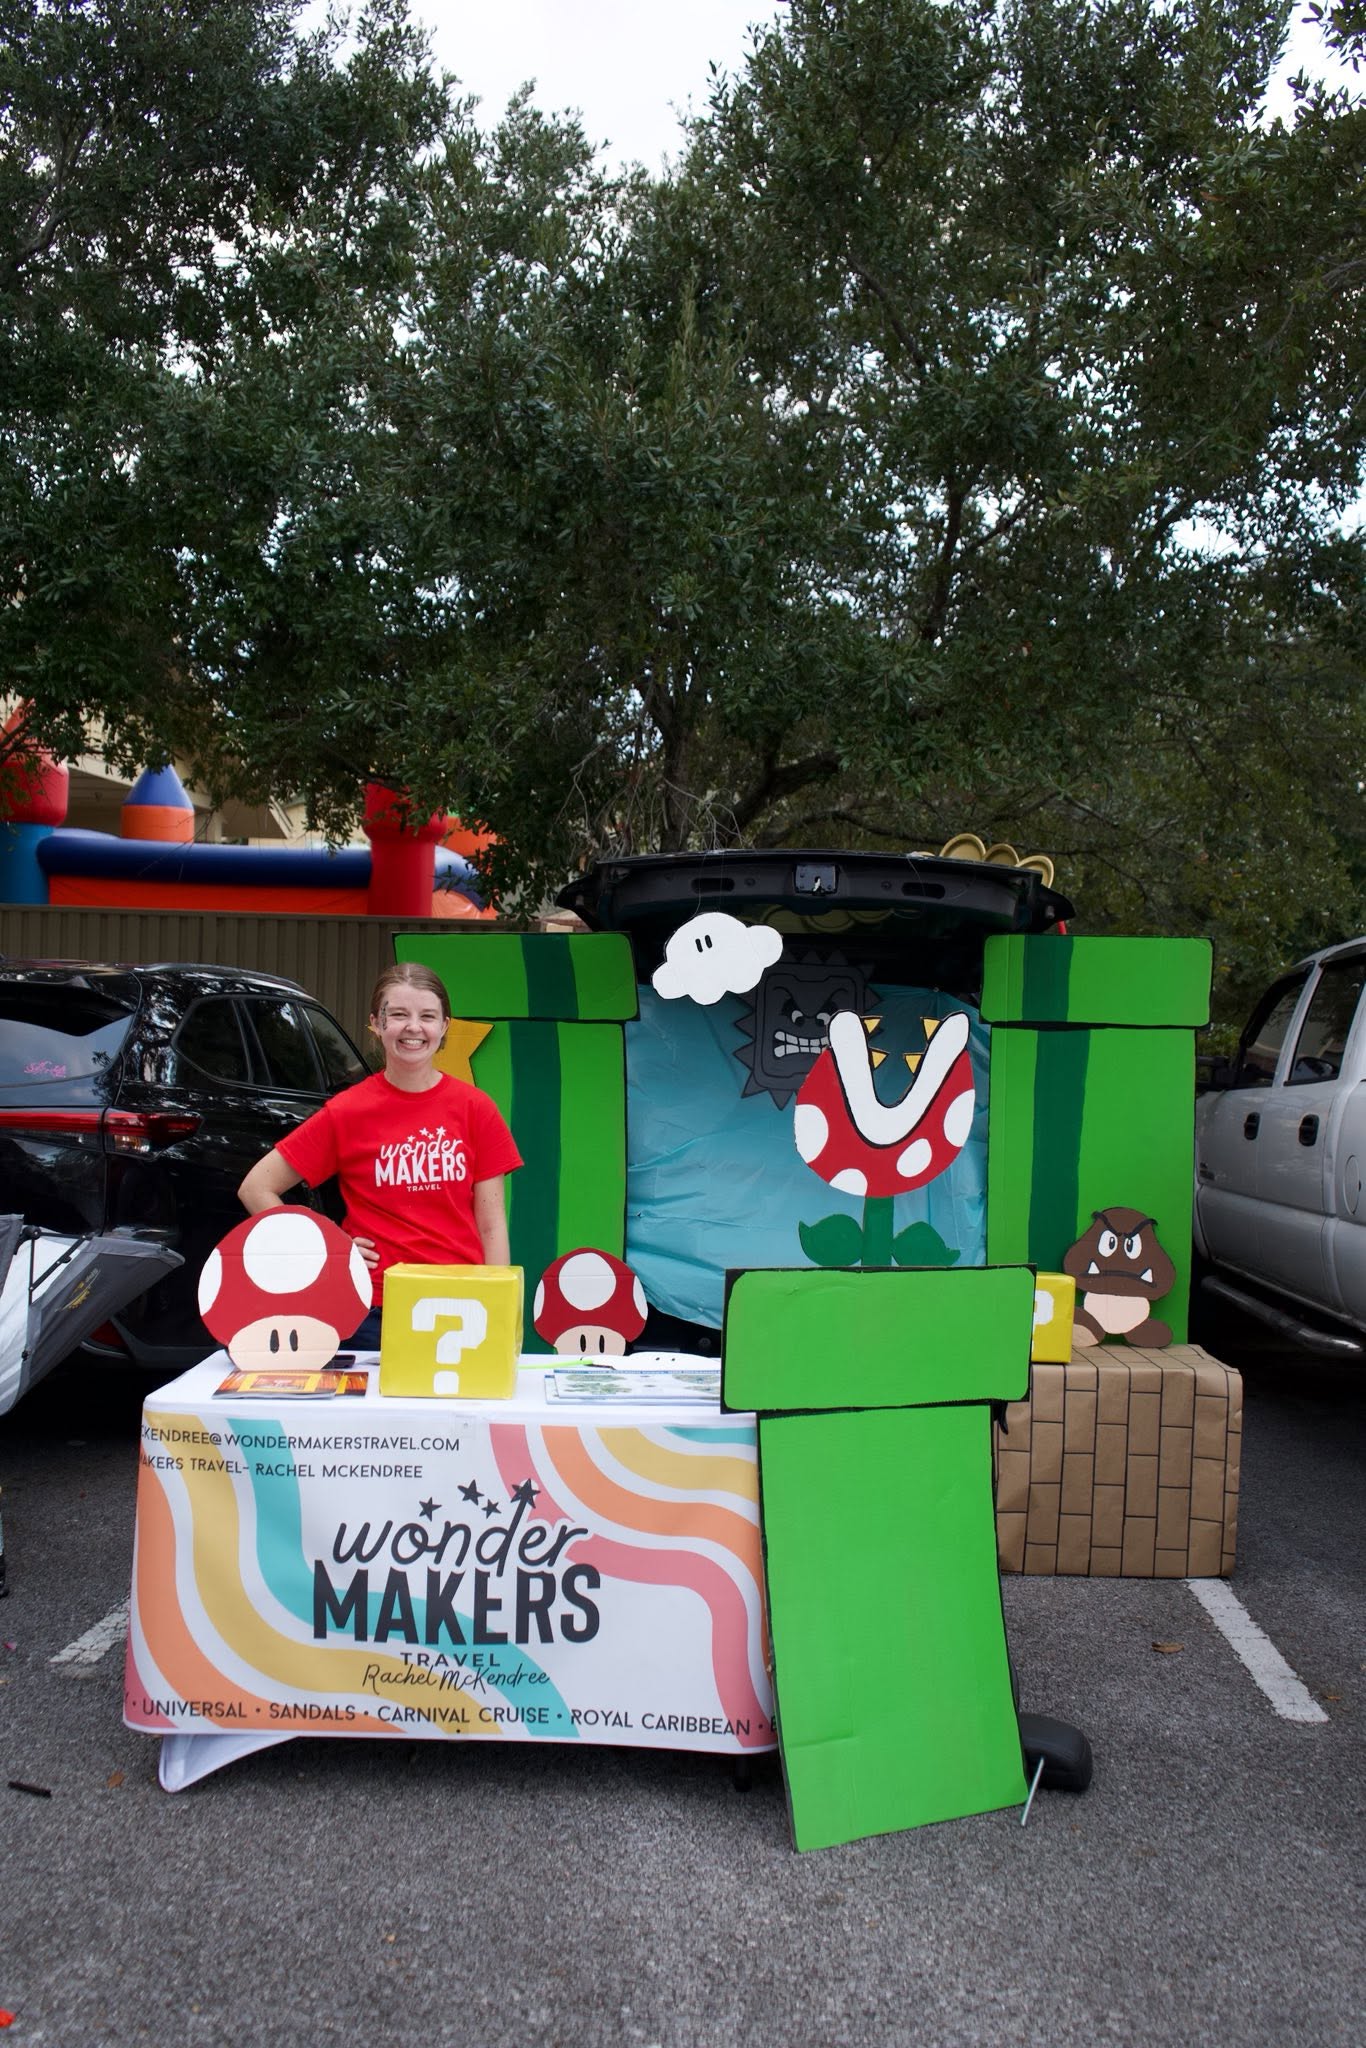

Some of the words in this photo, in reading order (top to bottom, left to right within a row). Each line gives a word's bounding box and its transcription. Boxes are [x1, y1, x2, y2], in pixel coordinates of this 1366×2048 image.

[380, 1129, 463, 1160] wonder
[375, 1152, 466, 1187] MAKERS
[407, 1183, 441, 1192] TRAVEL
[255, 1462, 316, 1478] RACHEL
[322, 1464, 423, 1479] MCKENDREE
[333, 1479, 589, 1578] wonder
[313, 1559, 601, 1646] MAKERS
[400, 1652, 501, 1667] TRAVEL
[362, 1663, 437, 1695] Rachel
[438, 1663, 551, 1695] McKendree
[142, 1697, 247, 1719] UNIVERSAL
[269, 1702, 356, 1720] SANDALS
[377, 1705, 470, 1723] CARNIVAL
[478, 1707, 550, 1724] CRUISE
[570, 1709, 633, 1728] ROYAL
[641, 1713, 750, 1735] CARIBBEAN
